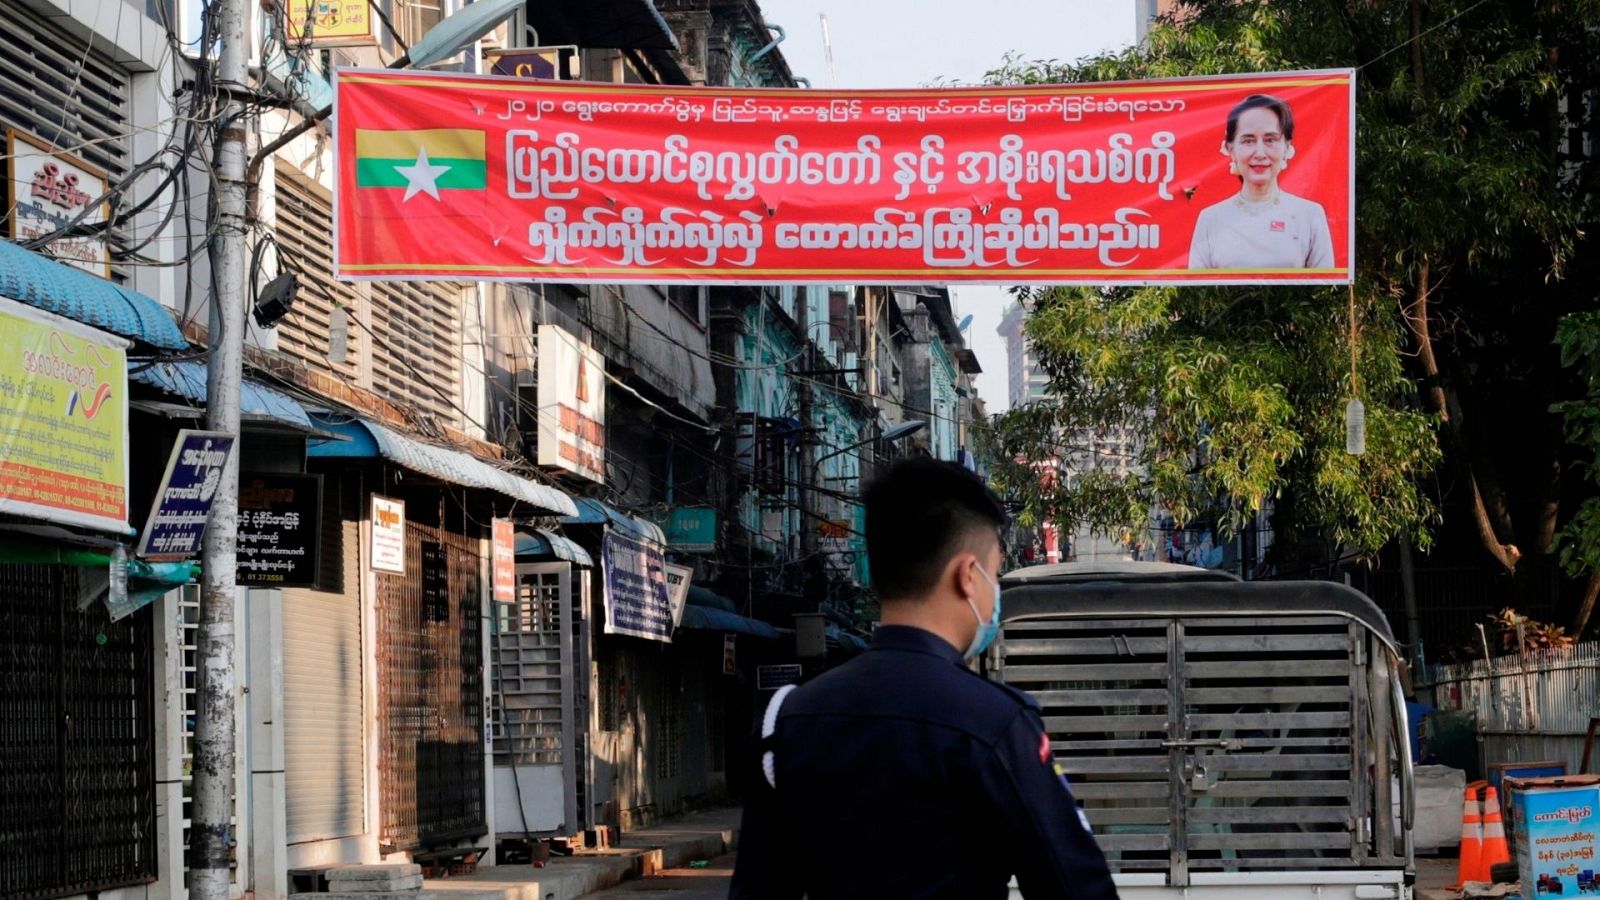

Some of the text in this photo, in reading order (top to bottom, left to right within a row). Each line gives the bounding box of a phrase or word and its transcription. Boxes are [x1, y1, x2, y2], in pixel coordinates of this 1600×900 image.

[497, 100, 555, 121] ၂၀၂၀
[562, 97, 705, 122] ရွေးကောက်ပွဲမှ
[505, 129, 1176, 201] ပြည်ထောင်စုလွှတ်တော် နှင့် အစိုးရသစ်ကို
[523, 206, 1160, 267] လှိုက်လှိုက်လှဲလှဲ ထောက်ခံကြိုဆိုပါသည်။
[666, 573, 685, 586] UBY
